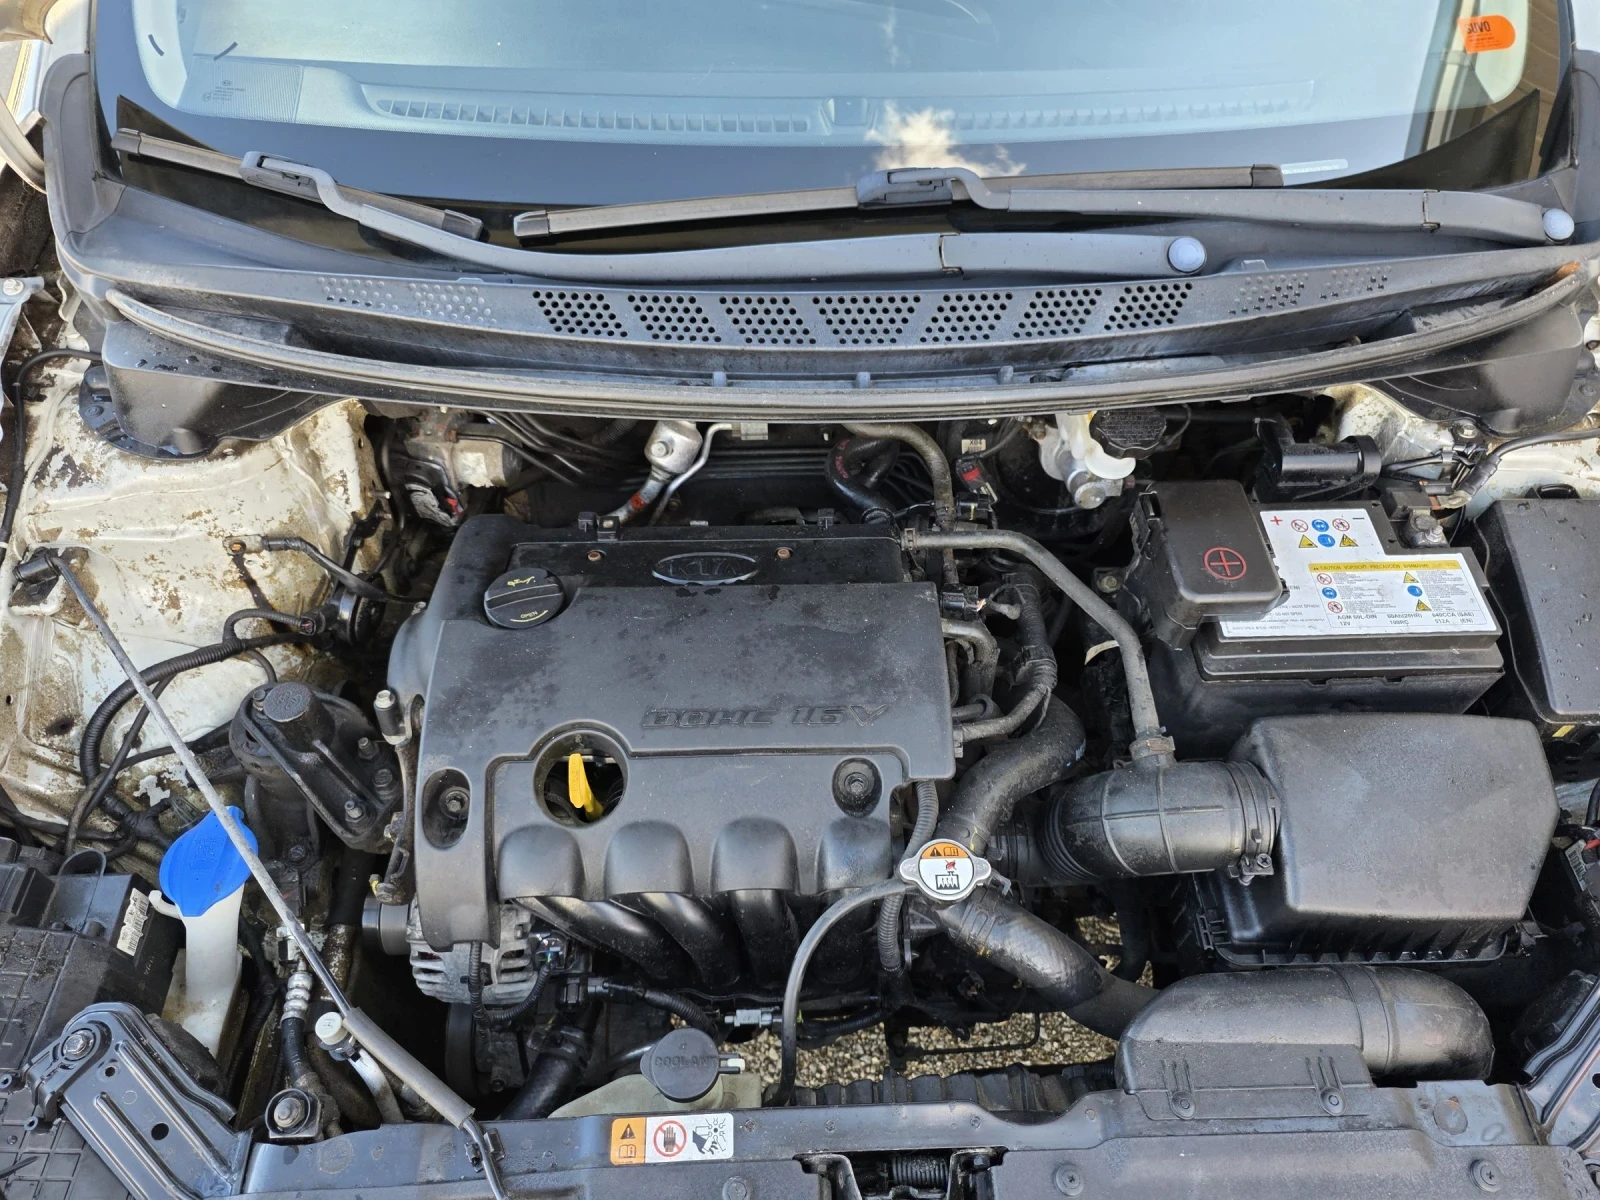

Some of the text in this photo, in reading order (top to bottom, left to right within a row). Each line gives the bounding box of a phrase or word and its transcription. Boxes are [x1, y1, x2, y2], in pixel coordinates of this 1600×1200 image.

[520, 610, 538, 619] OPEN
[640, 703, 887, 729] DOHC 16V
[654, 1055, 718, 1068] COOLANT
